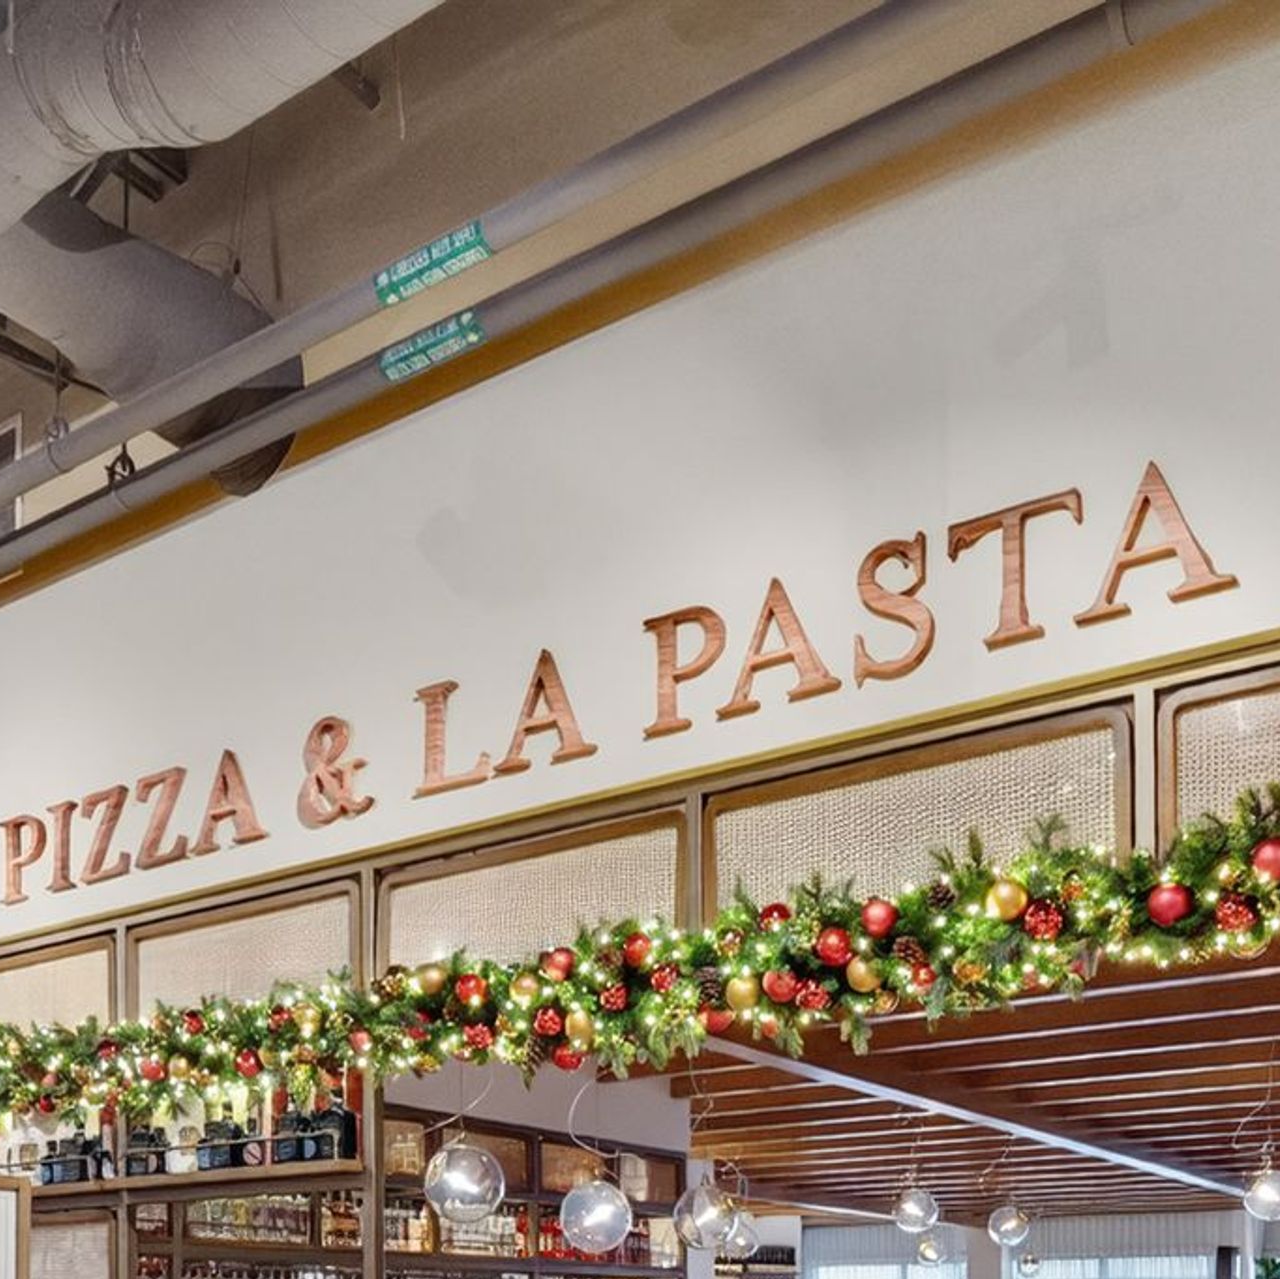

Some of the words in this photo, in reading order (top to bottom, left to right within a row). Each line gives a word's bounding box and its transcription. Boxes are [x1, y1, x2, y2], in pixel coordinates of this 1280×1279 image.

[297, 715, 376, 829] &
[412, 648, 599, 799] LA
[642, 459, 1240, 741] PASTA
